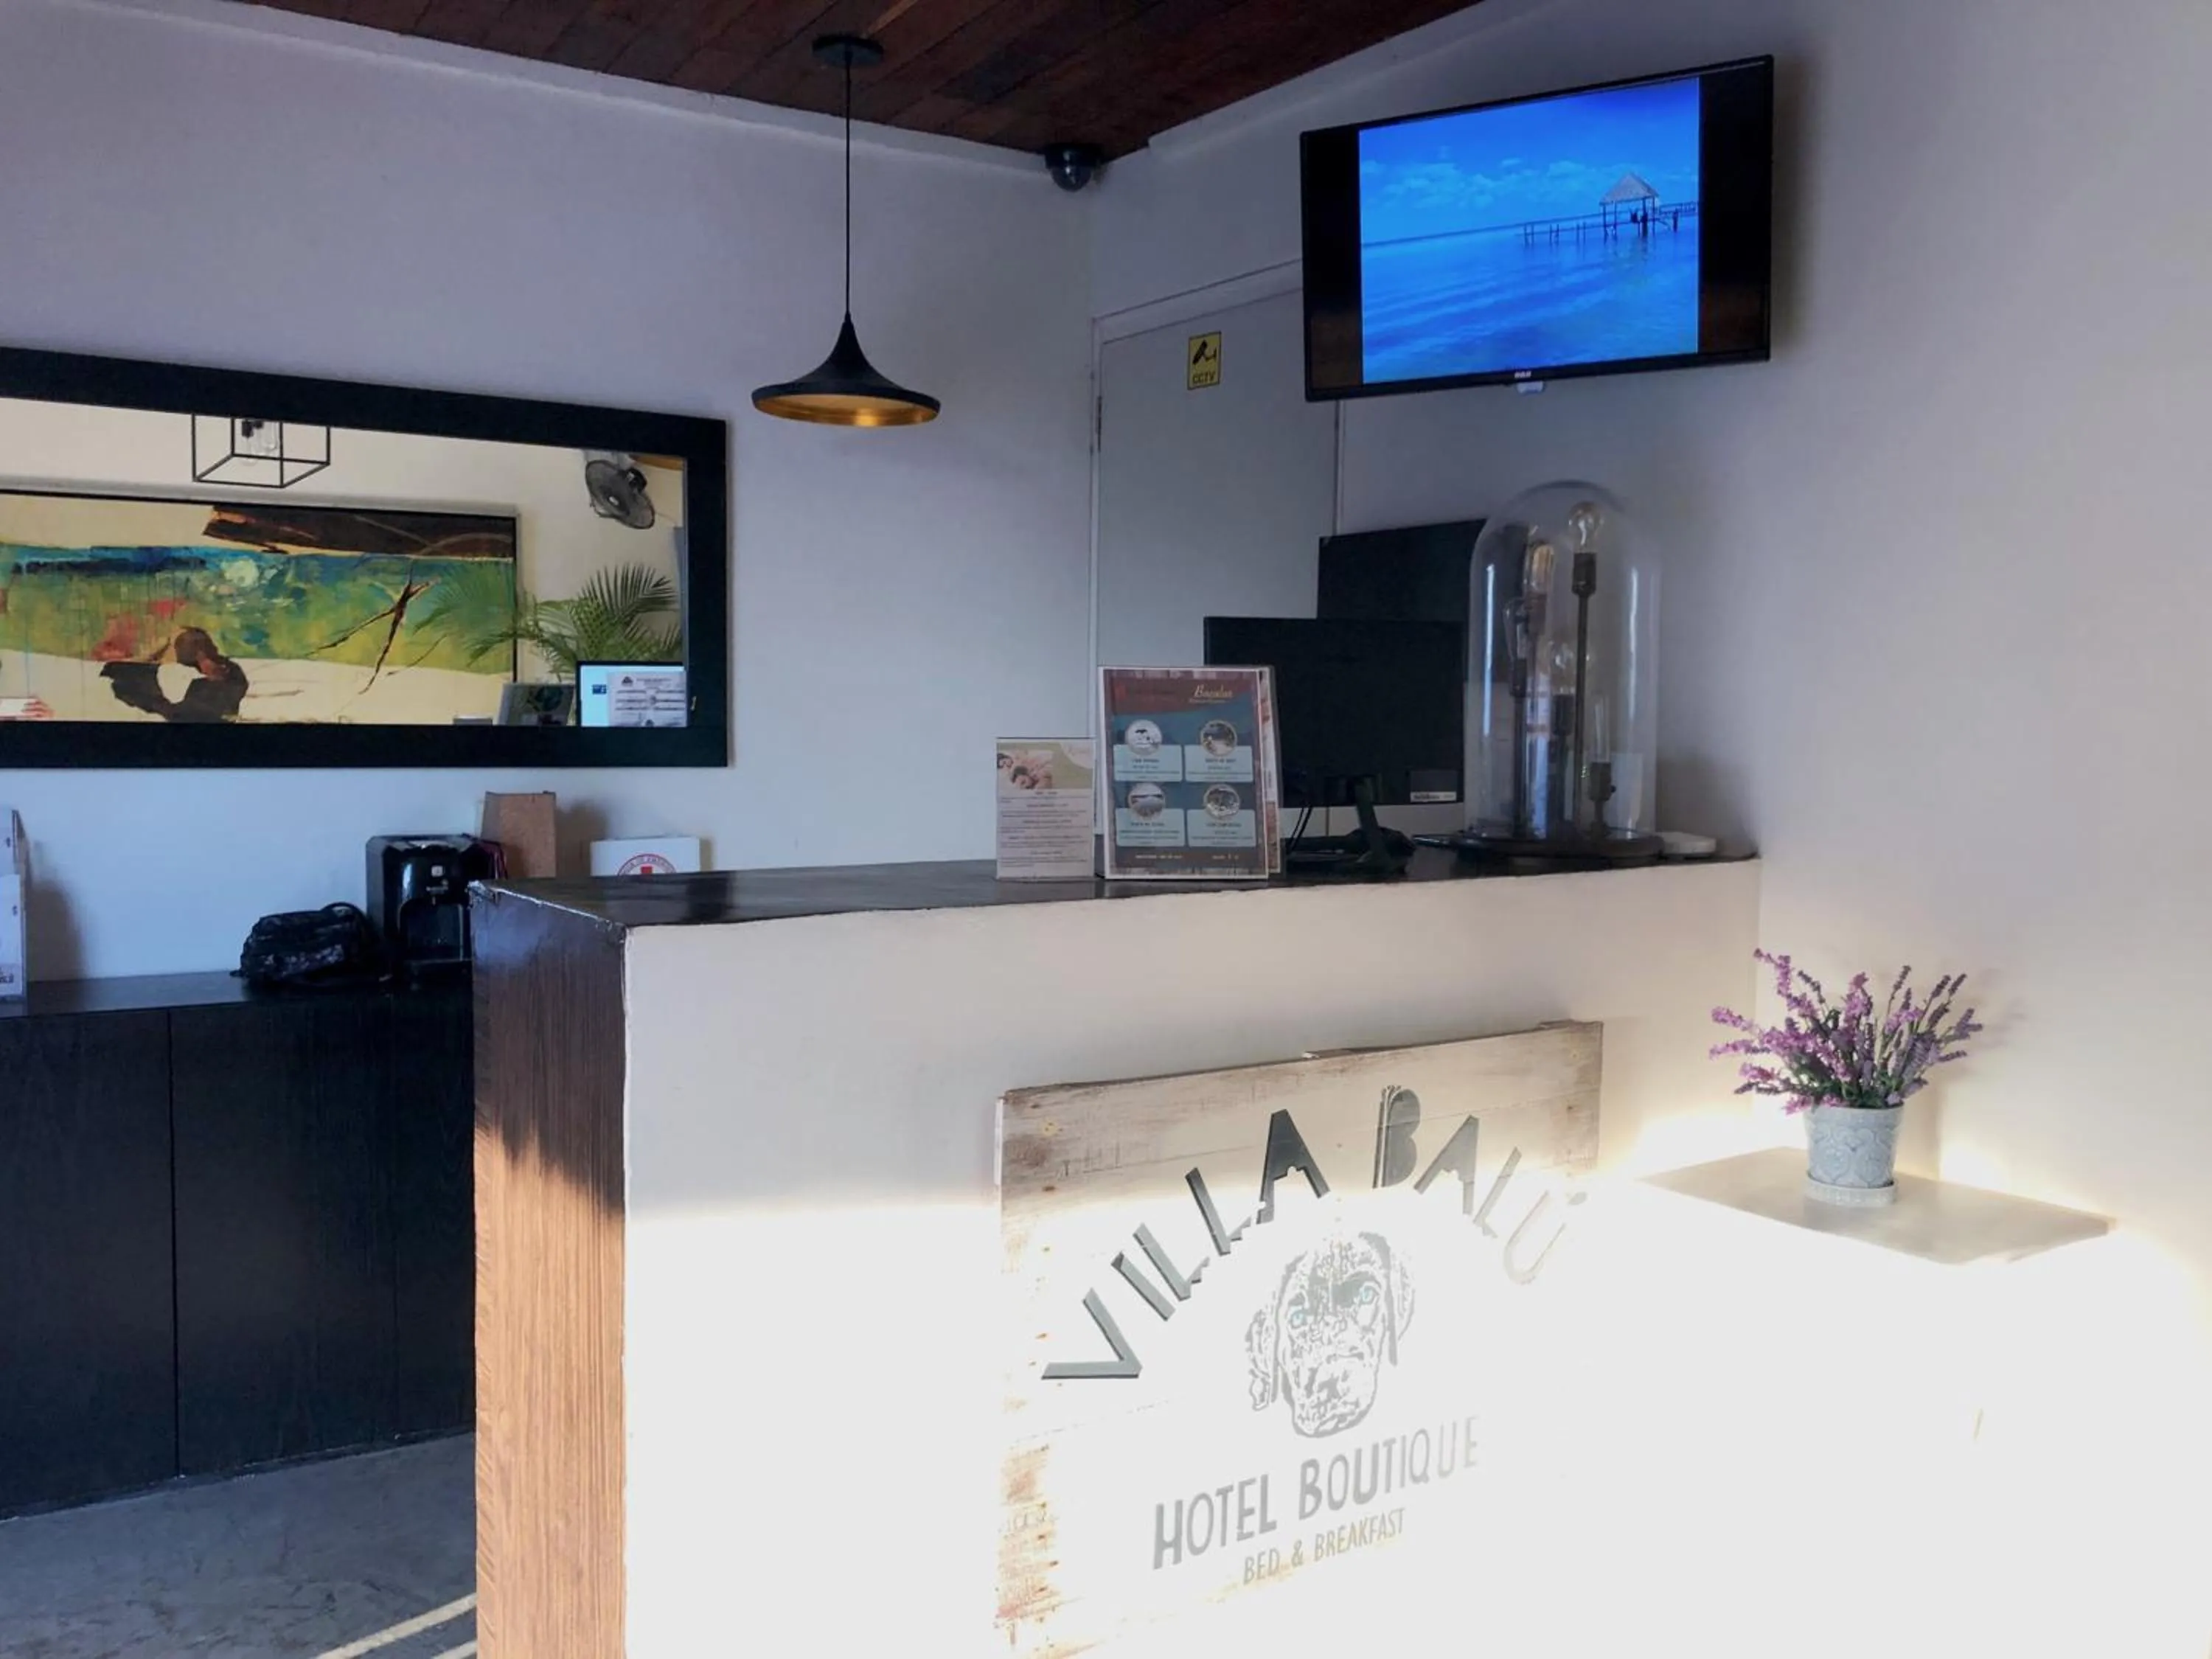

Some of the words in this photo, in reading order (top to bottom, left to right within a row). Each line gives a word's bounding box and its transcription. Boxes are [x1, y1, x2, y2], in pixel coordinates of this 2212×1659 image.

[1192, 370, 1217, 384] CCTV
[1040, 1108, 1330, 1380] VILLA
[1152, 1474, 1277, 1570] HOTEL
[1298, 1415, 1479, 1522] BOUTIQUE
[1242, 1547, 1281, 1585] BED
[1291, 1540, 1304, 1566] &
[1314, 1507, 1405, 1562] BREAKFAST
